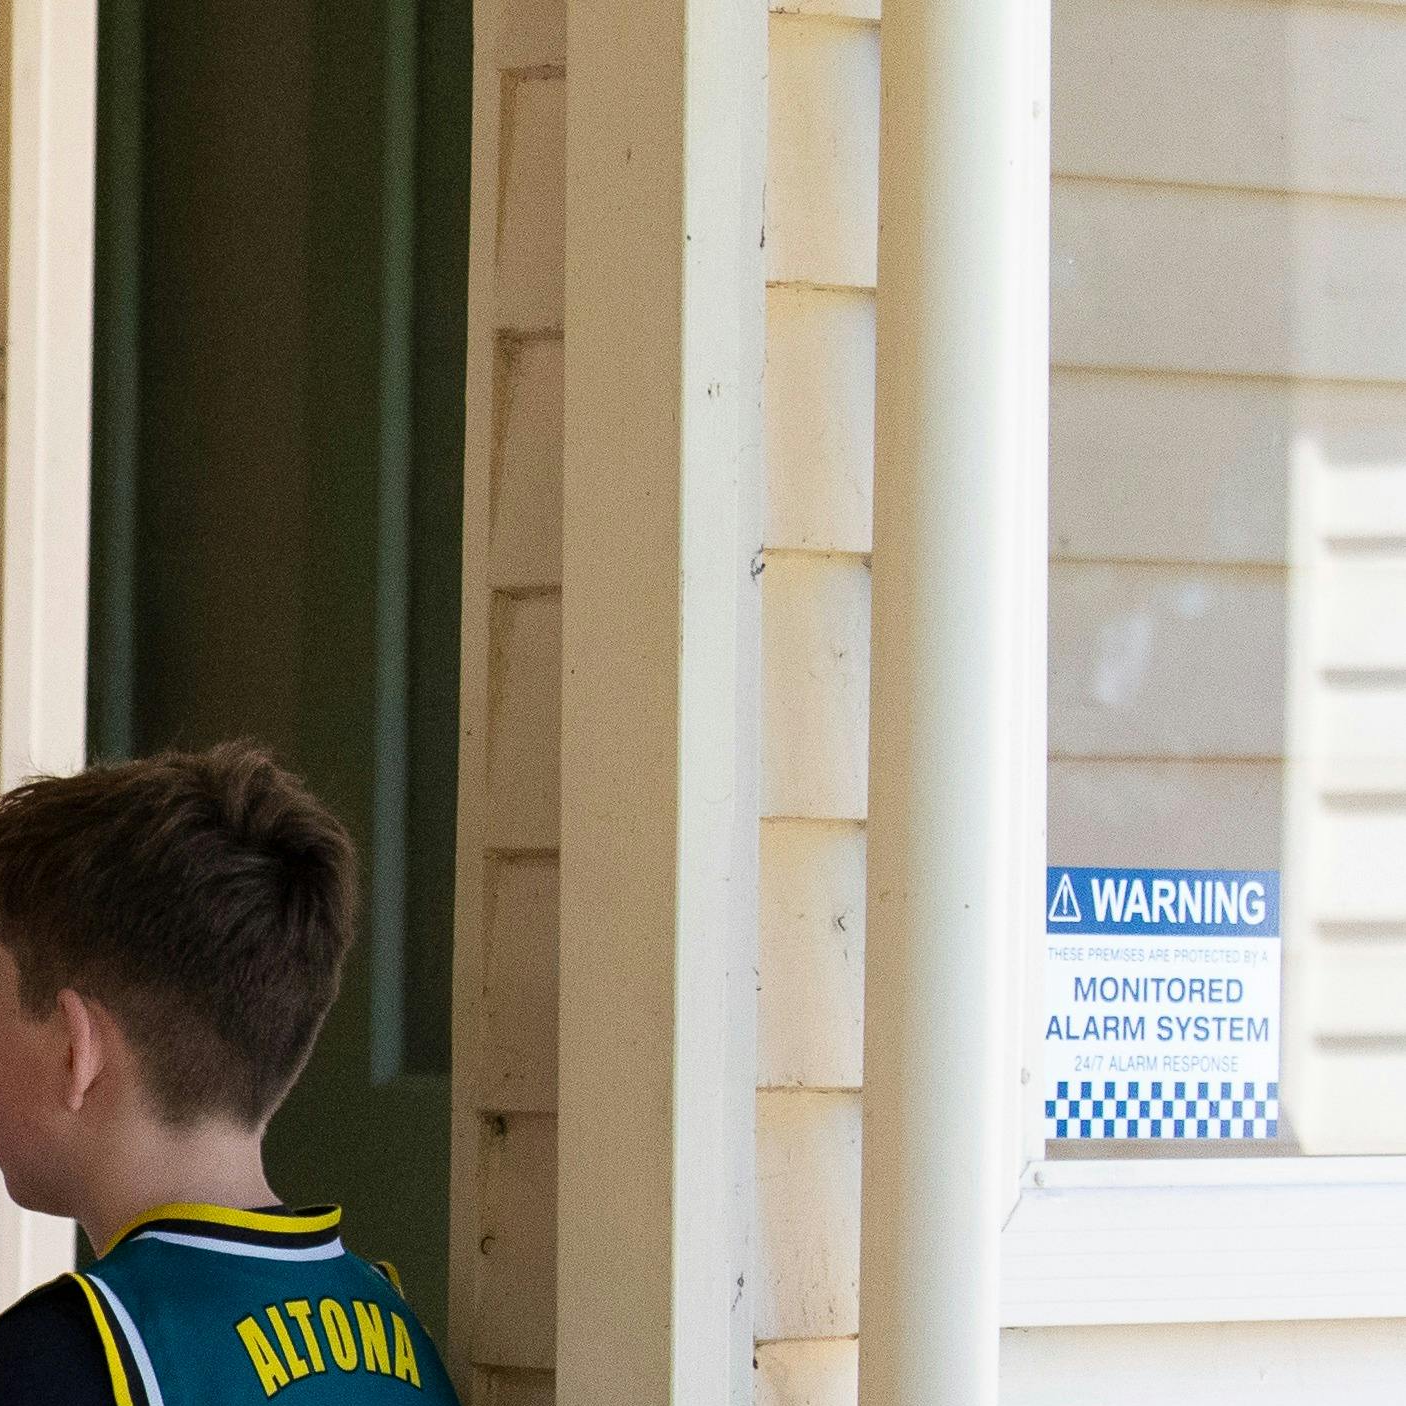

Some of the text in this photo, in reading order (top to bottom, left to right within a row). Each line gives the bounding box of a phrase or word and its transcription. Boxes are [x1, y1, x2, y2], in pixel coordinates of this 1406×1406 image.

[1091, 878, 1266, 925] WARNING
[1048, 947, 1084, 961] THESE
[1088, 947, 1145, 962] PREMISES
[1148, 948, 1169, 962] ARE
[1174, 949, 1239, 964] PROTECTED
[1074, 976, 1244, 1003] MONITORED
[1045, 1015, 1270, 1042] ALARM SYSTEM
[1074, 1055, 1239, 1073] 24/7 ALARM RESPONSE
[236, 1298, 422, 1398] ALTONA
